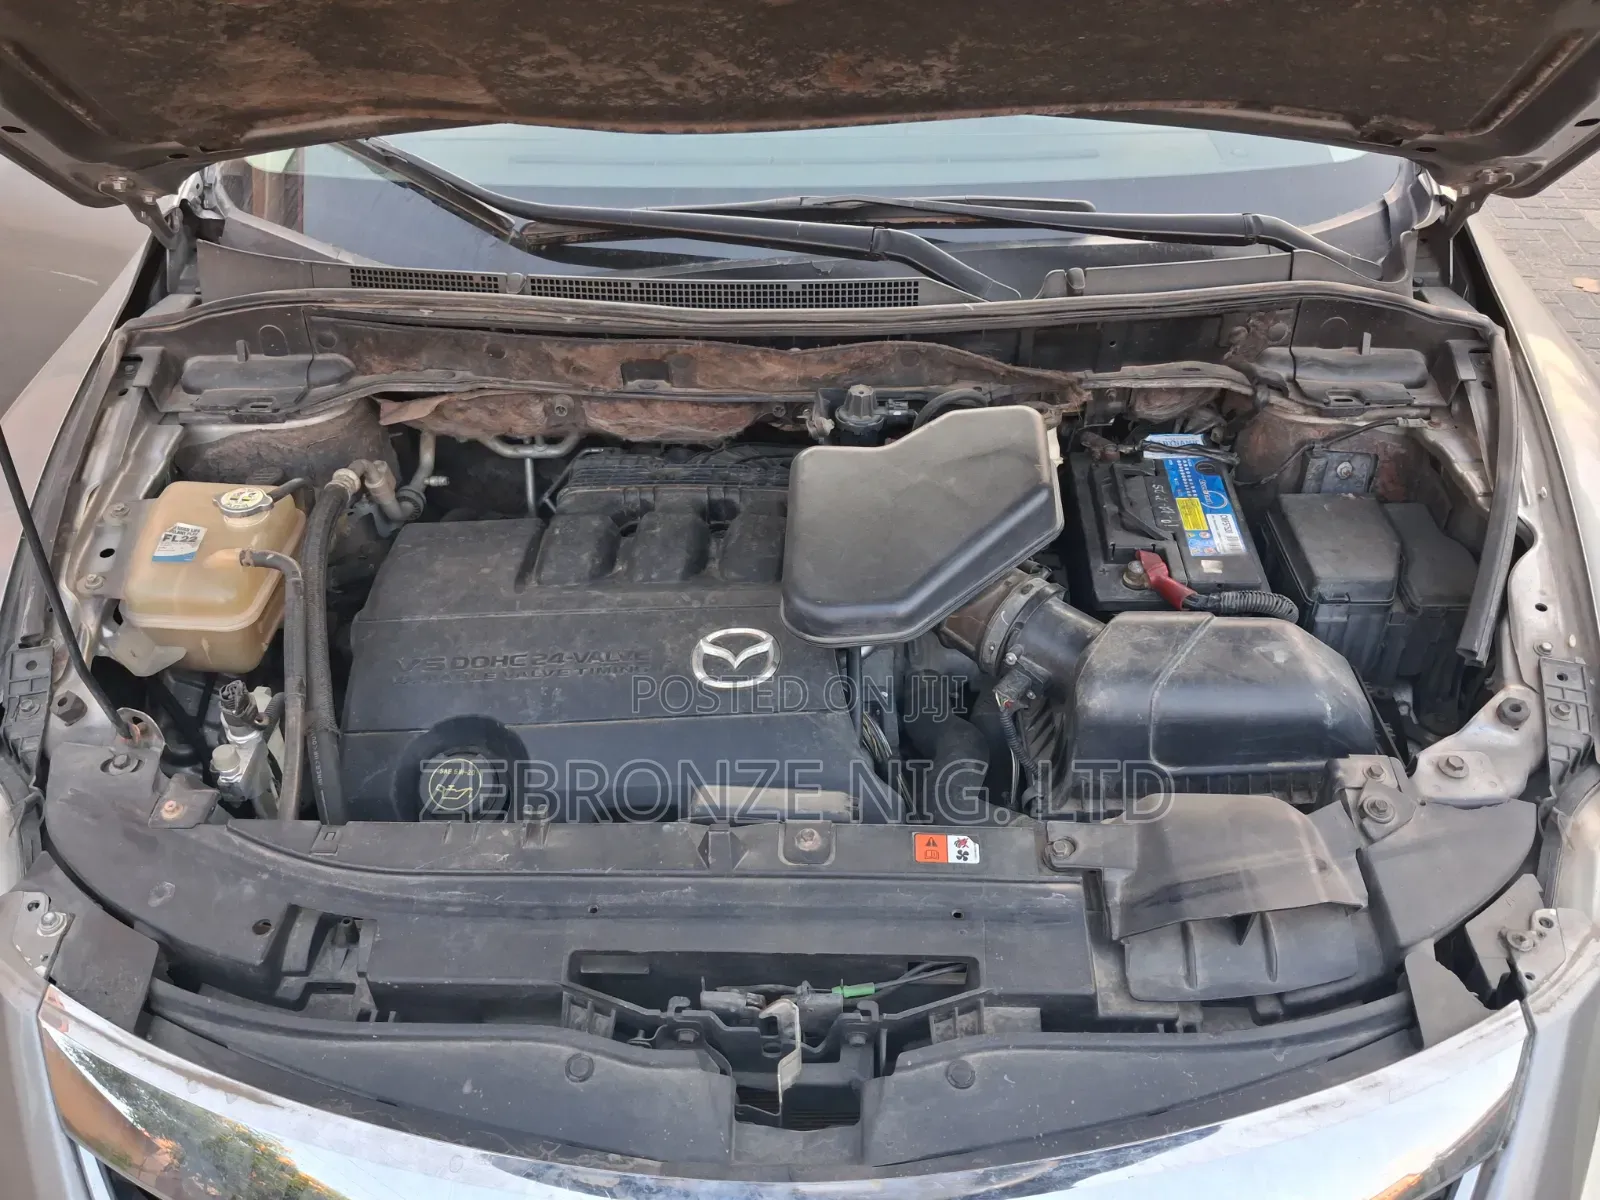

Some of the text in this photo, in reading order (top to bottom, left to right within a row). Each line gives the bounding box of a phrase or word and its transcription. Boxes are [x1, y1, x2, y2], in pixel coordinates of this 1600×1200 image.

[162, 534, 198, 543] FL22
[450, 652, 528, 670] DOHC
[531, 649, 650, 667] 24-VALVE
[503, 669, 571, 681] VALVE
